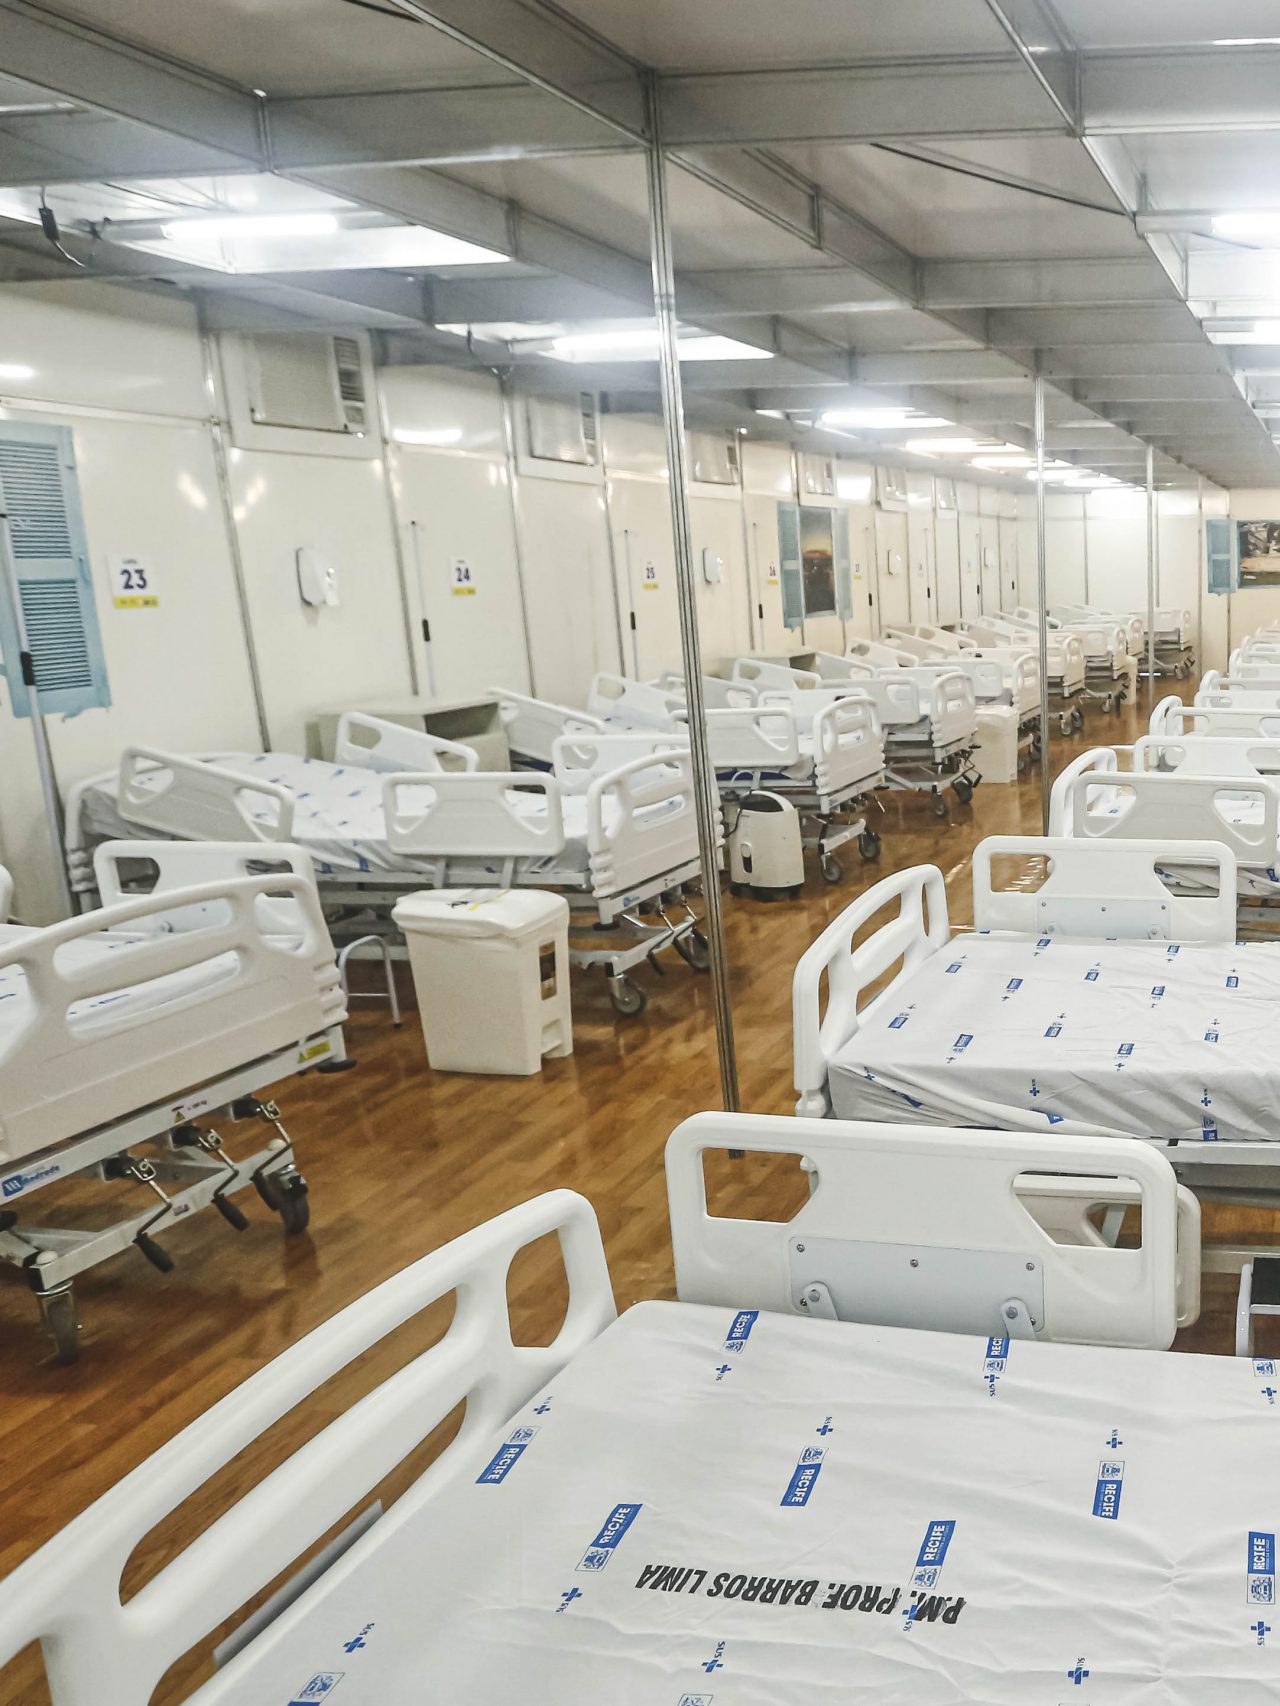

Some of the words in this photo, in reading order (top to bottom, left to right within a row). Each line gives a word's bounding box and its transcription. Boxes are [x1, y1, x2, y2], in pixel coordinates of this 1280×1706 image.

[120, 568, 147, 589] 23
[455, 567, 470, 582] 24
[487, 1447, 520, 1480] RECIFE
[791, 1469, 815, 1503] RECIFE
[1102, 1483, 1117, 1517] RECIFE
[598, 1507, 630, 1544] RECIFE
[922, 1525, 945, 1561] RECIFE
[635, 1564, 708, 1594] LIMA
[706, 1572, 820, 1606] BARROS
[821, 1582, 902, 1615] PROF.
[714, 1641, 725, 1659] SUS
